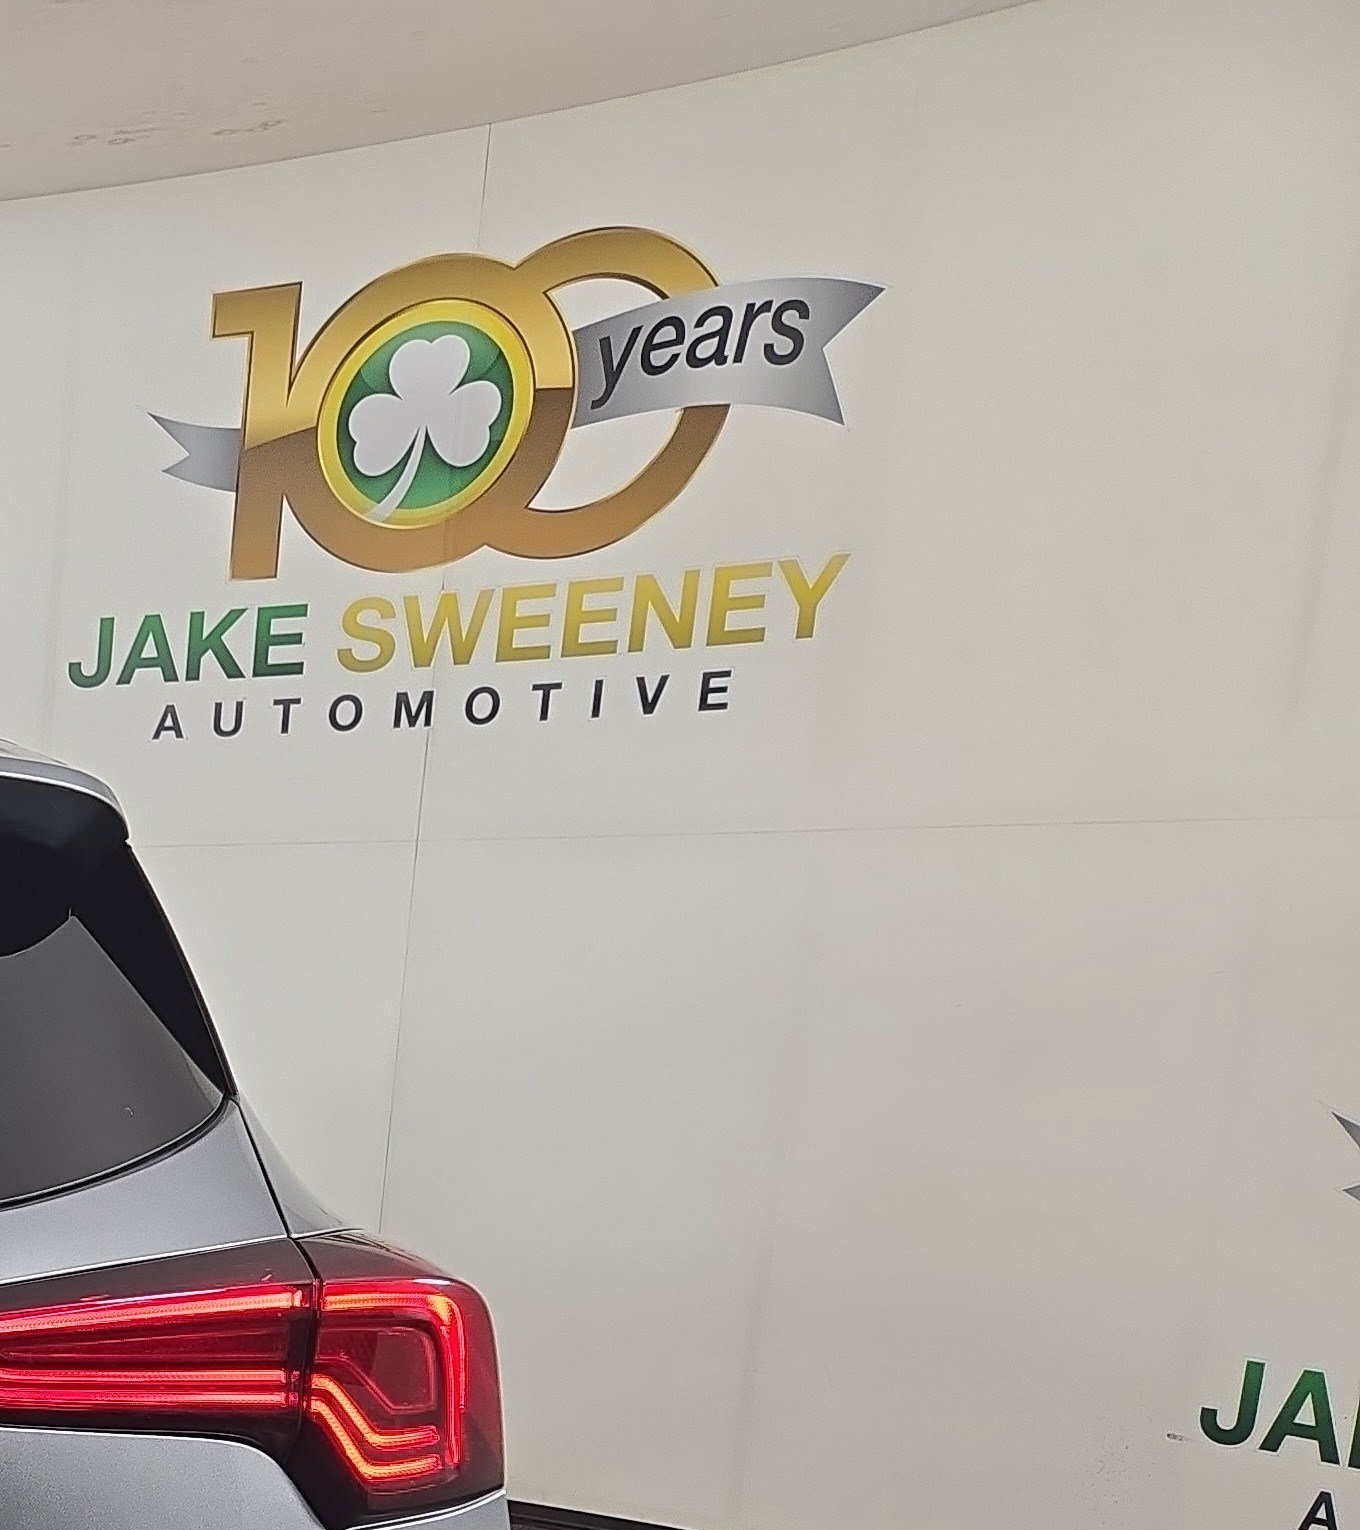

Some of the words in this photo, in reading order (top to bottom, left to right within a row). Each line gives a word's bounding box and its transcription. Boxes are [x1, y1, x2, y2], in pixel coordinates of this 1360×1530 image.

[212, 226, 732, 581] 100
[590, 295, 810, 410] years
[68, 603, 309, 689] JAKE
[336, 553, 850, 674] SWEENEY
[152, 669, 734, 740] AUTOMOTIVE
[1200, 1358, 1360, 1470] JA
